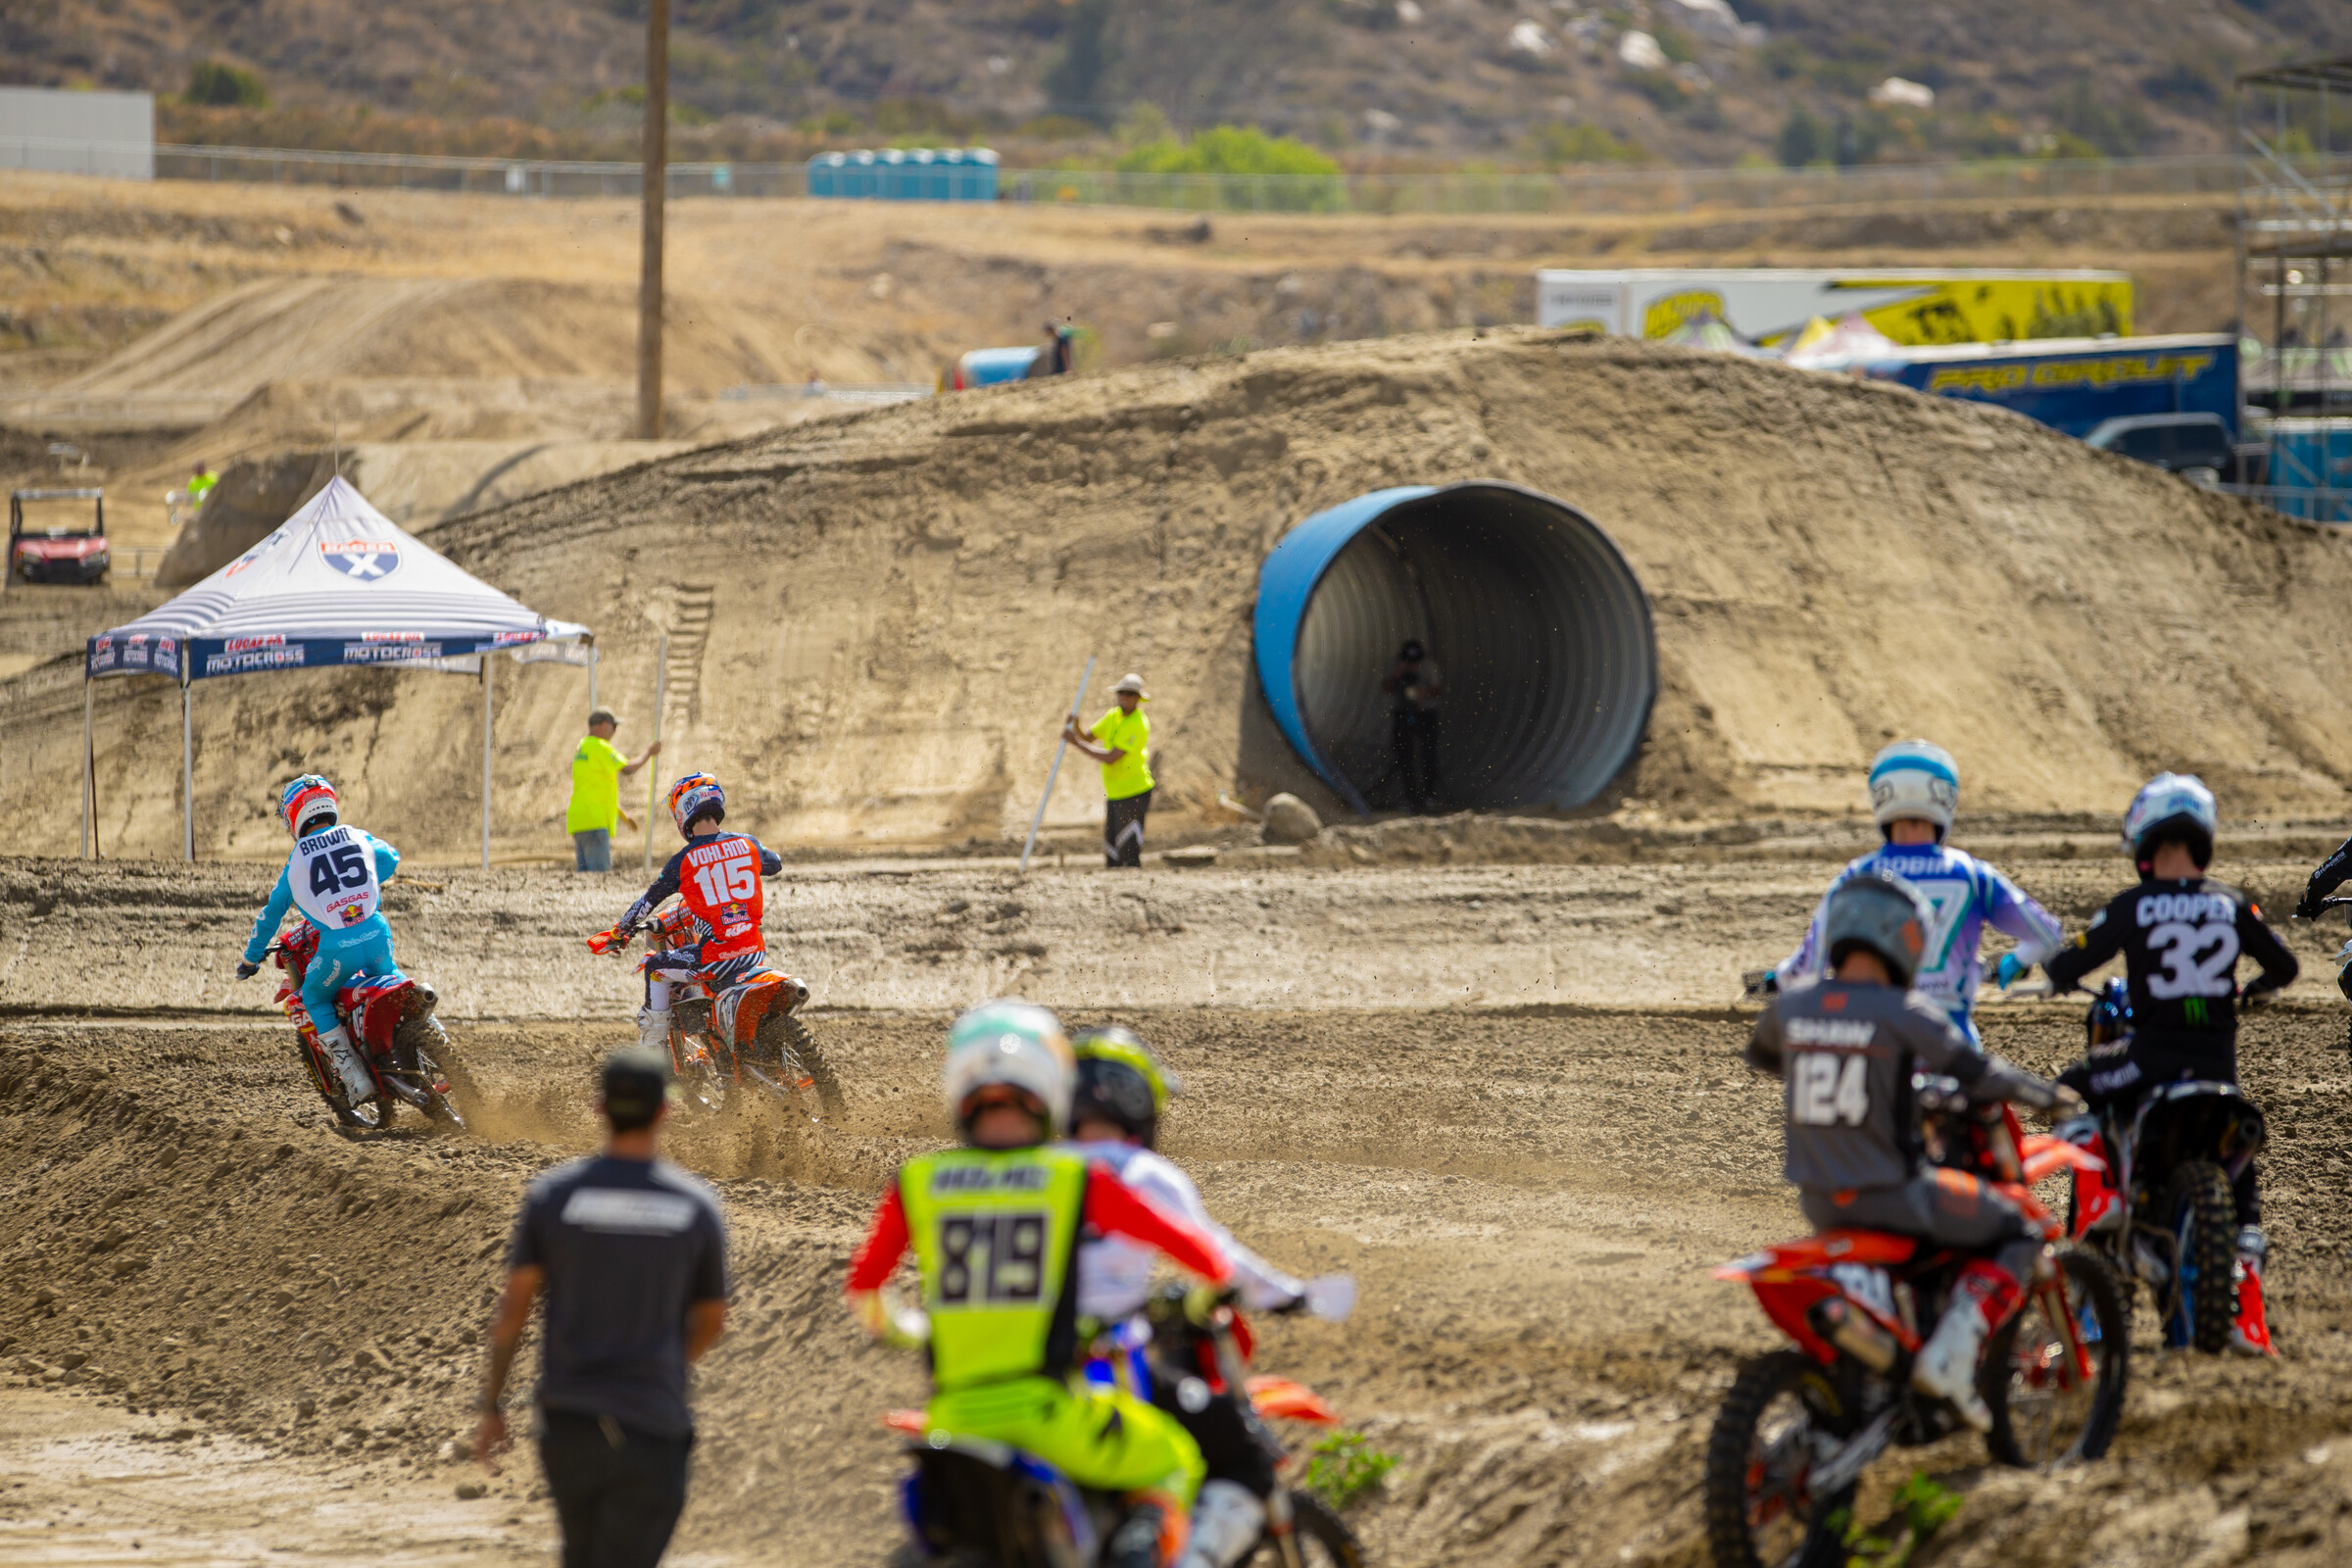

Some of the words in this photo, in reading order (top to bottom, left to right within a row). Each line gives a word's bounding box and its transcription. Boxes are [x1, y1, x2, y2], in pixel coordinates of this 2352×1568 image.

[1927, 364, 2028, 393] PRO
[341, 553, 386, 576] X
[227, 638, 264, 652] LUCAS
[344, 646, 442, 660] MOTOCROSS
[206, 649, 305, 673] MOTOCROSS
[299, 827, 351, 857] BROWN
[686, 838, 751, 868] VOHLAND
[309, 844, 368, 898] 45
[693, 855, 755, 907] 115
[326, 891, 369, 913] GASGAS
[2136, 893, 2237, 928] COOPER
[2146, 921, 2240, 1000] 32
[1786, 1017, 1877, 1048] SHAW
[1792, 1053, 1870, 1127] 124
[939, 1214, 1047, 1302] 819
